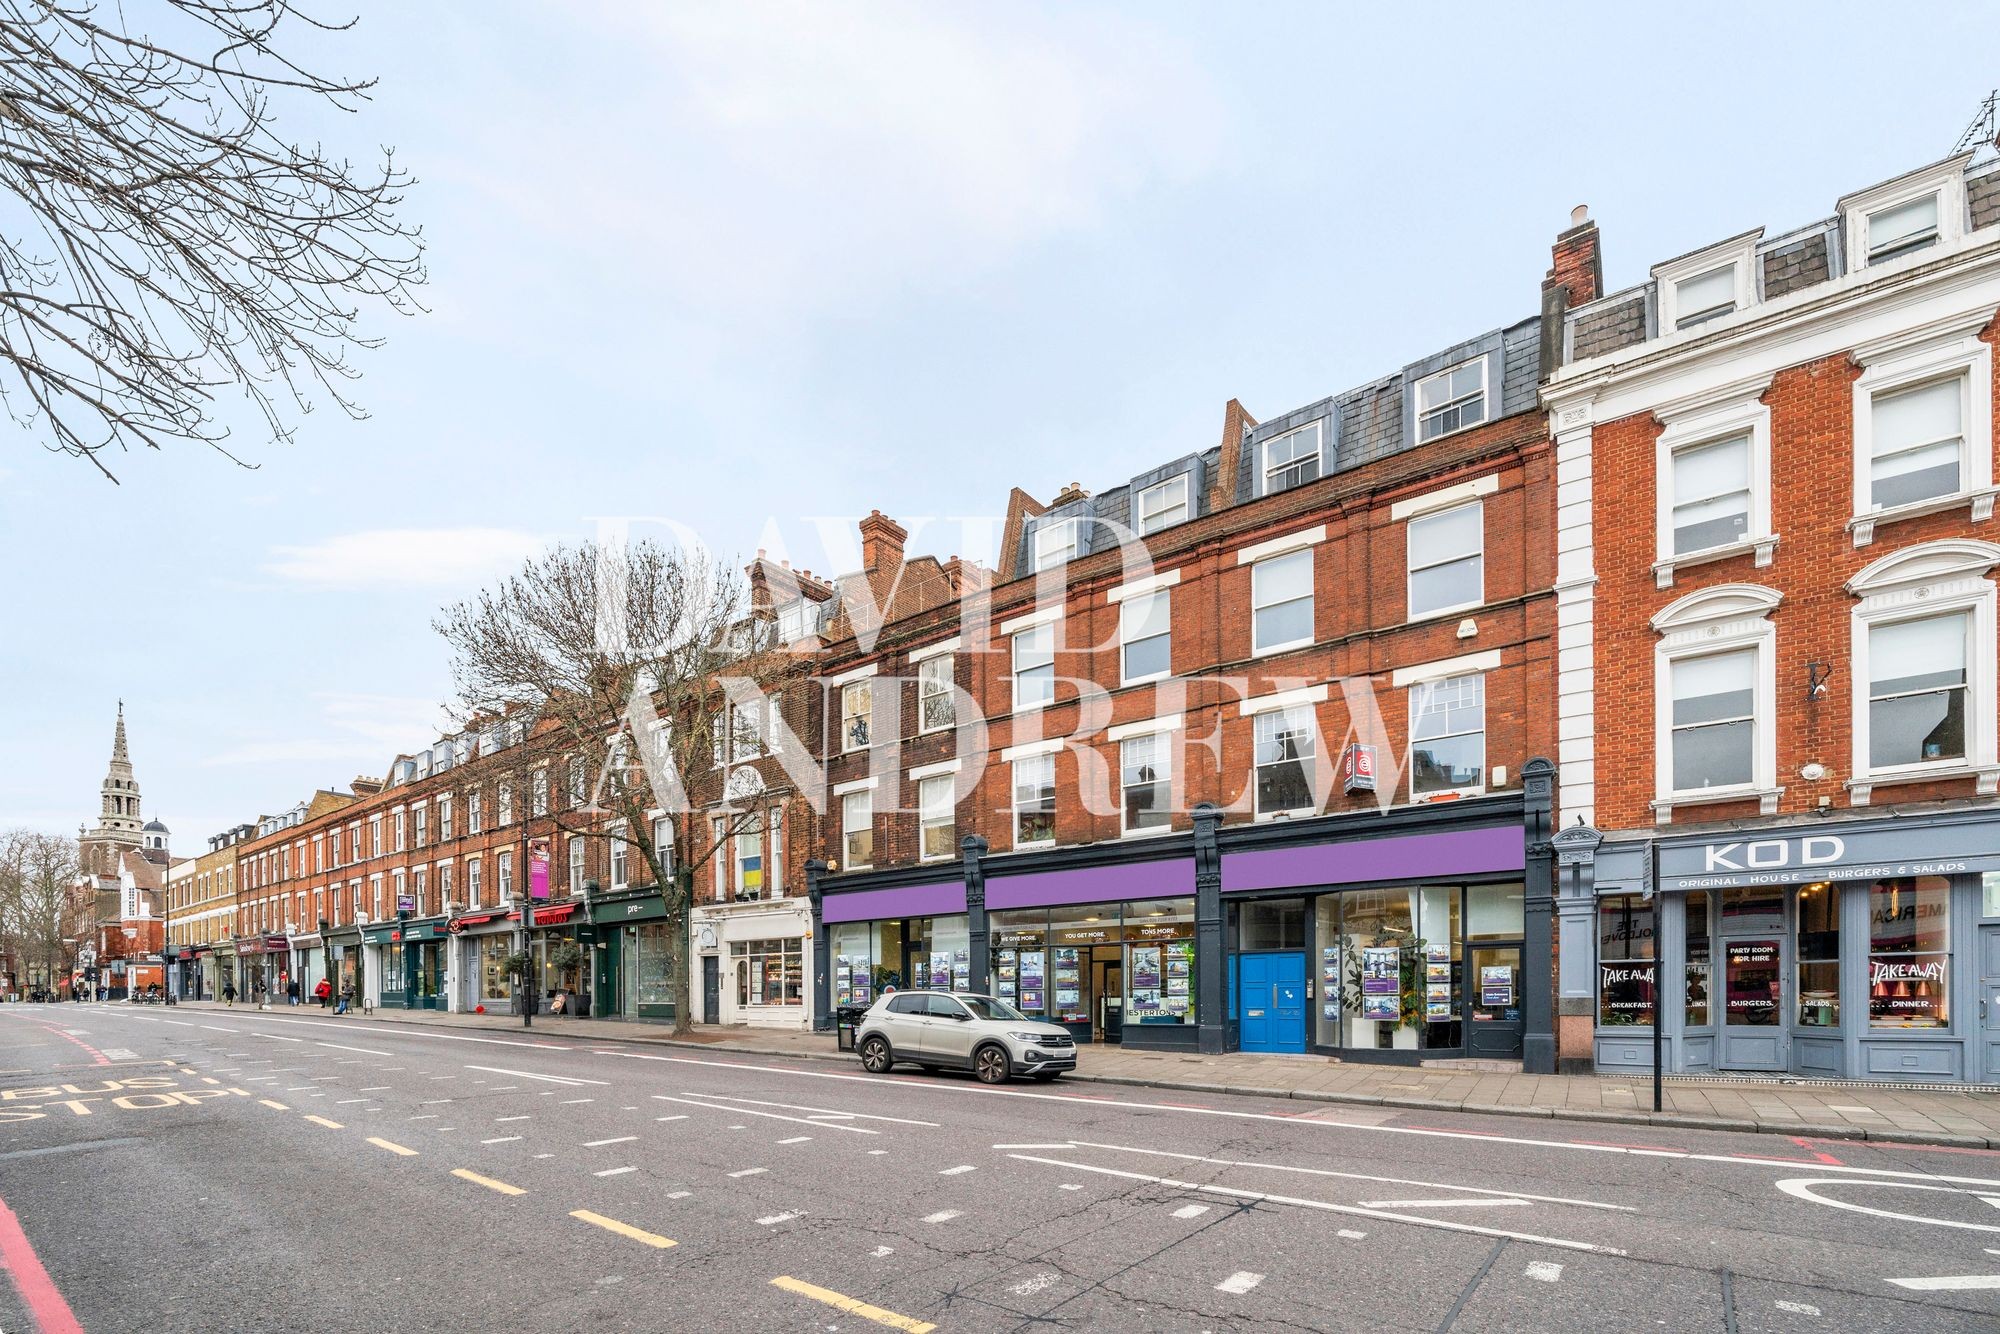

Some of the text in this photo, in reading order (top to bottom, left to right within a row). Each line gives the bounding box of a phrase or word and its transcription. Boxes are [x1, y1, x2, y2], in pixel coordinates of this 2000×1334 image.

[1706, 836, 1845, 871] KOD
[1679, 877, 1740, 888] ORIGINAL
[1750, 873, 1799, 884] HOUSE
[1828, 867, 1891, 879] BURGERS
[1912, 862, 1966, 874] SALADS
[1602, 966, 1655, 988] TAKEAWA
[1871, 959, 1947, 986] TAKEAWAY
[0, 1077, 179, 1100] BUS
[0, 1090, 230, 1123] STOP
